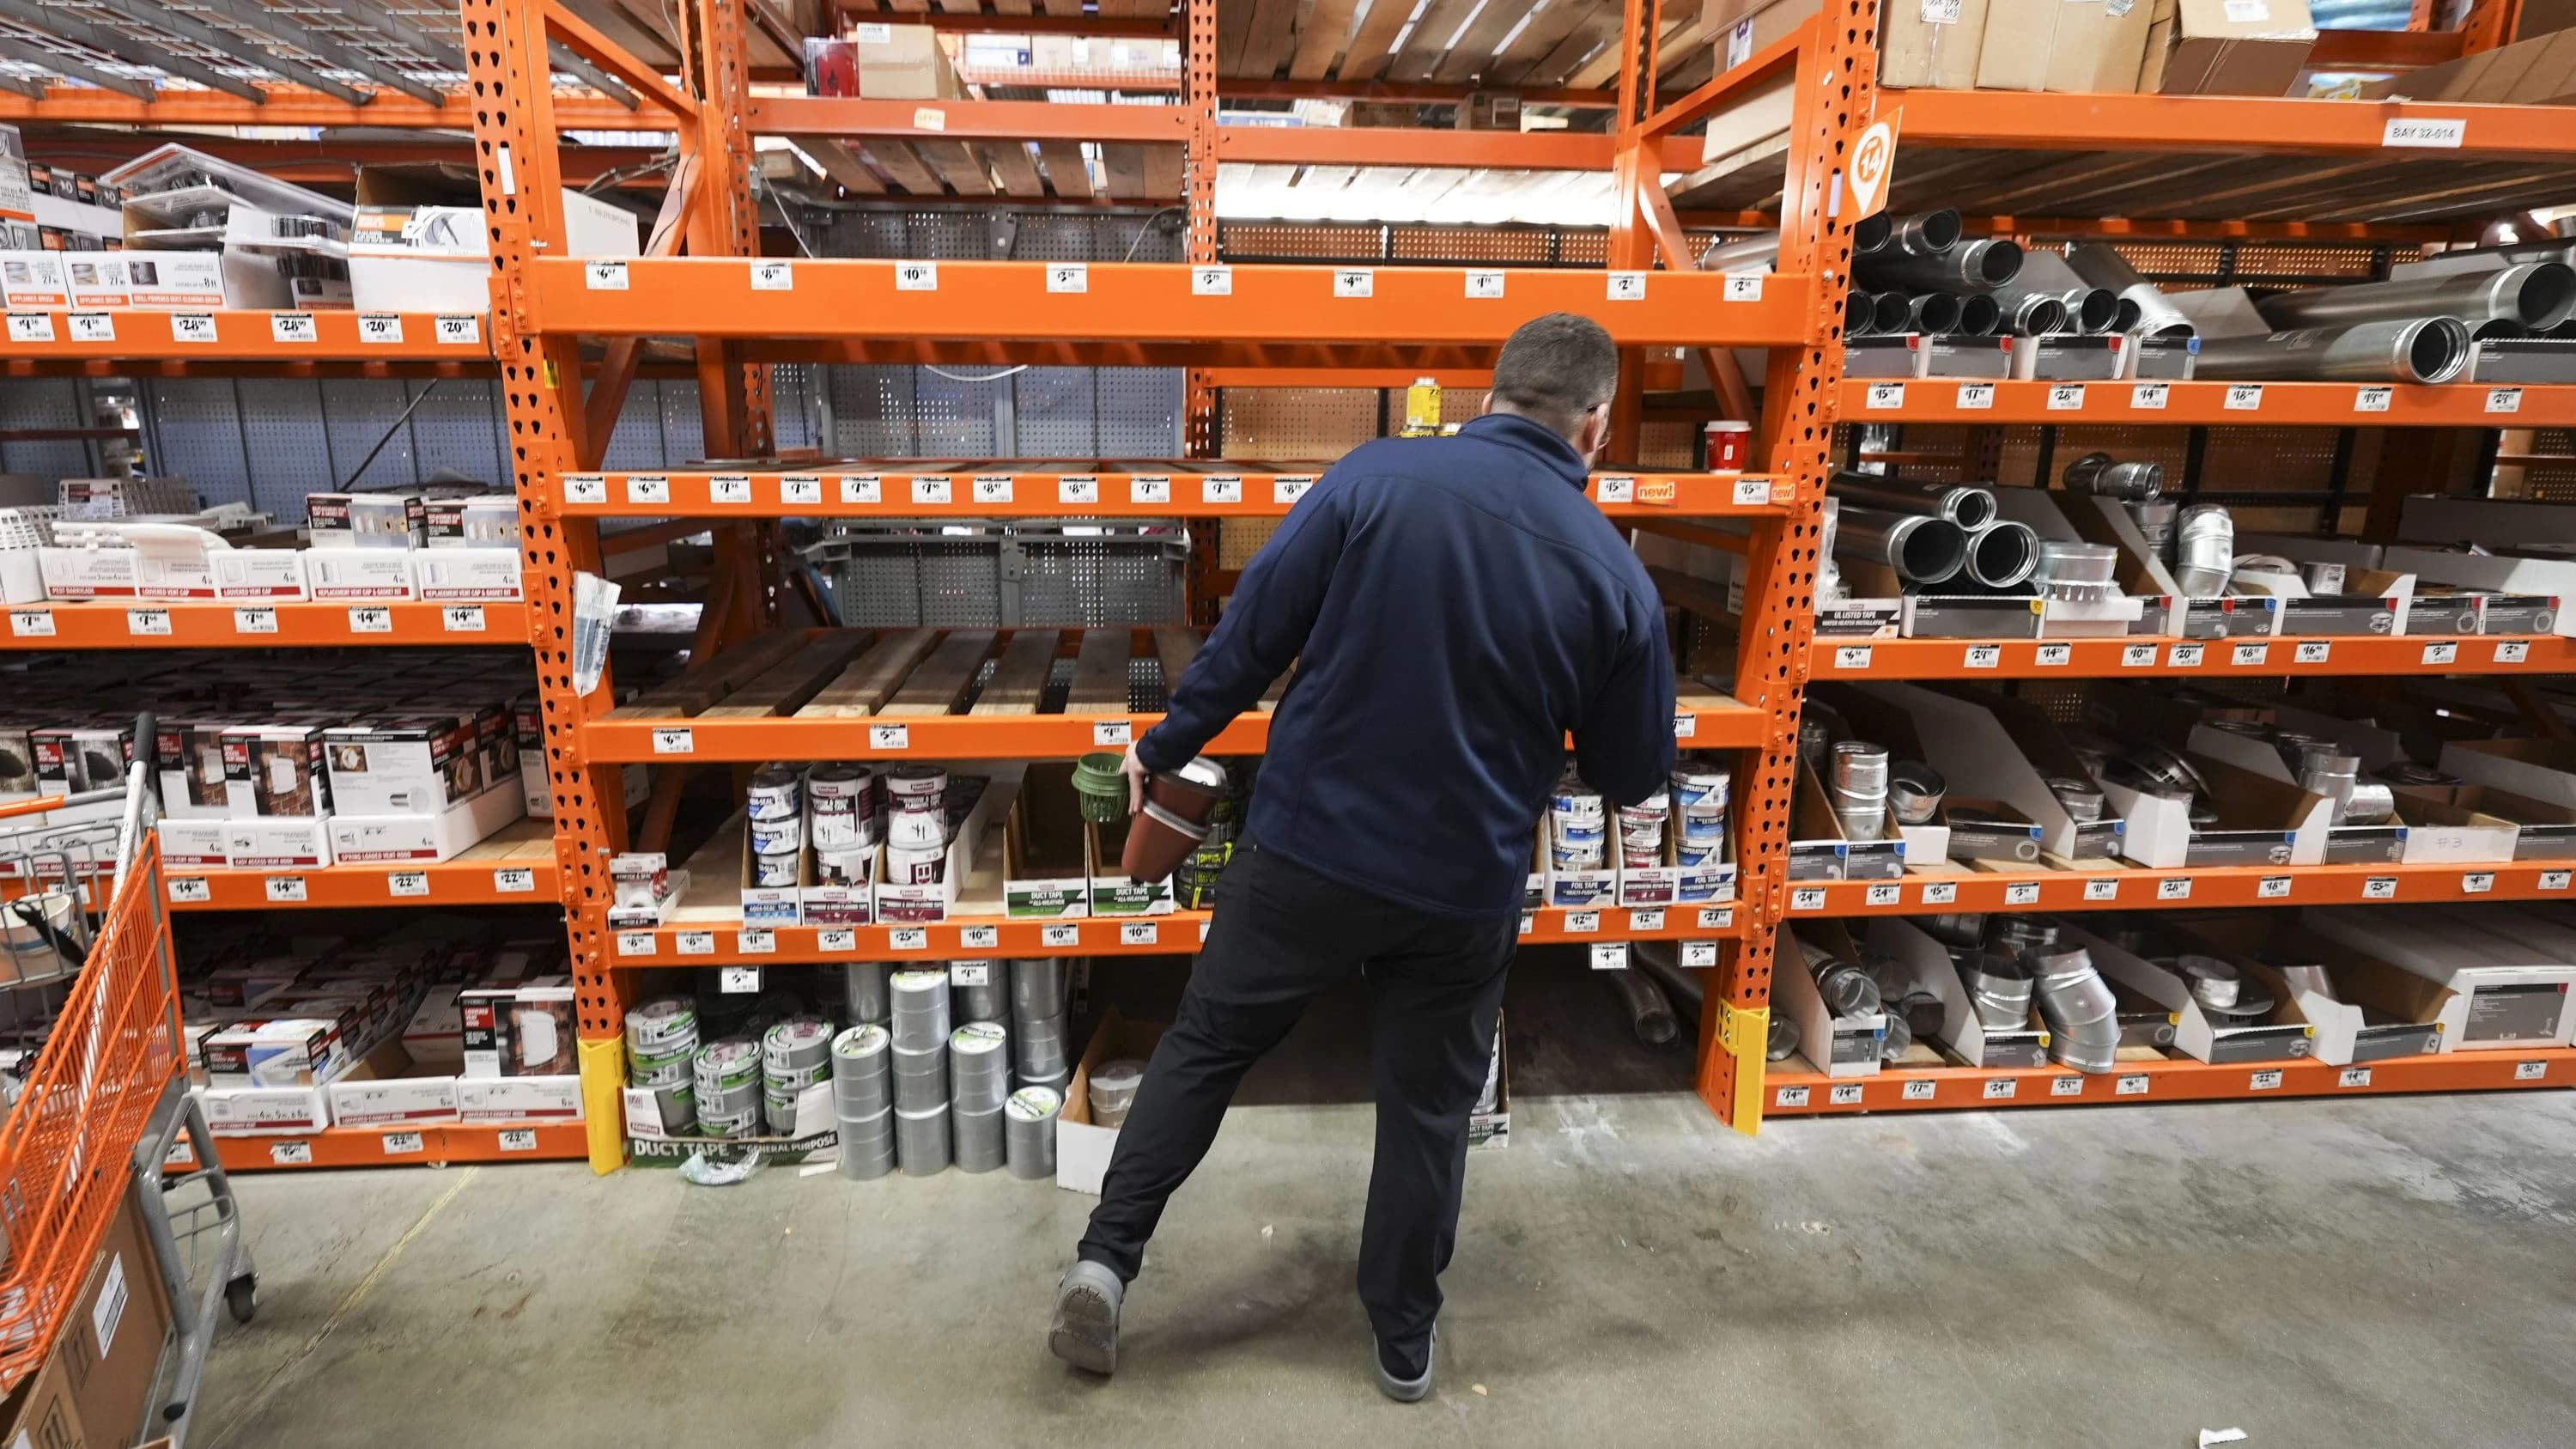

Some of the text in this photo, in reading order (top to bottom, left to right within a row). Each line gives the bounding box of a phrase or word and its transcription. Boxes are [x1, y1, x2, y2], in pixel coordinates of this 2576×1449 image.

[2392, 127, 2415, 138] BAY
[1861, 148, 1880, 178] 14
[1639, 483, 1674, 498] new!
[1771, 483, 1795, 499] new!
[778, 904, 790, 912] TAPE
[634, 1140, 730, 1158] DUCT TAPE
[746, 1134, 837, 1155] GENERAL PURPOSE
